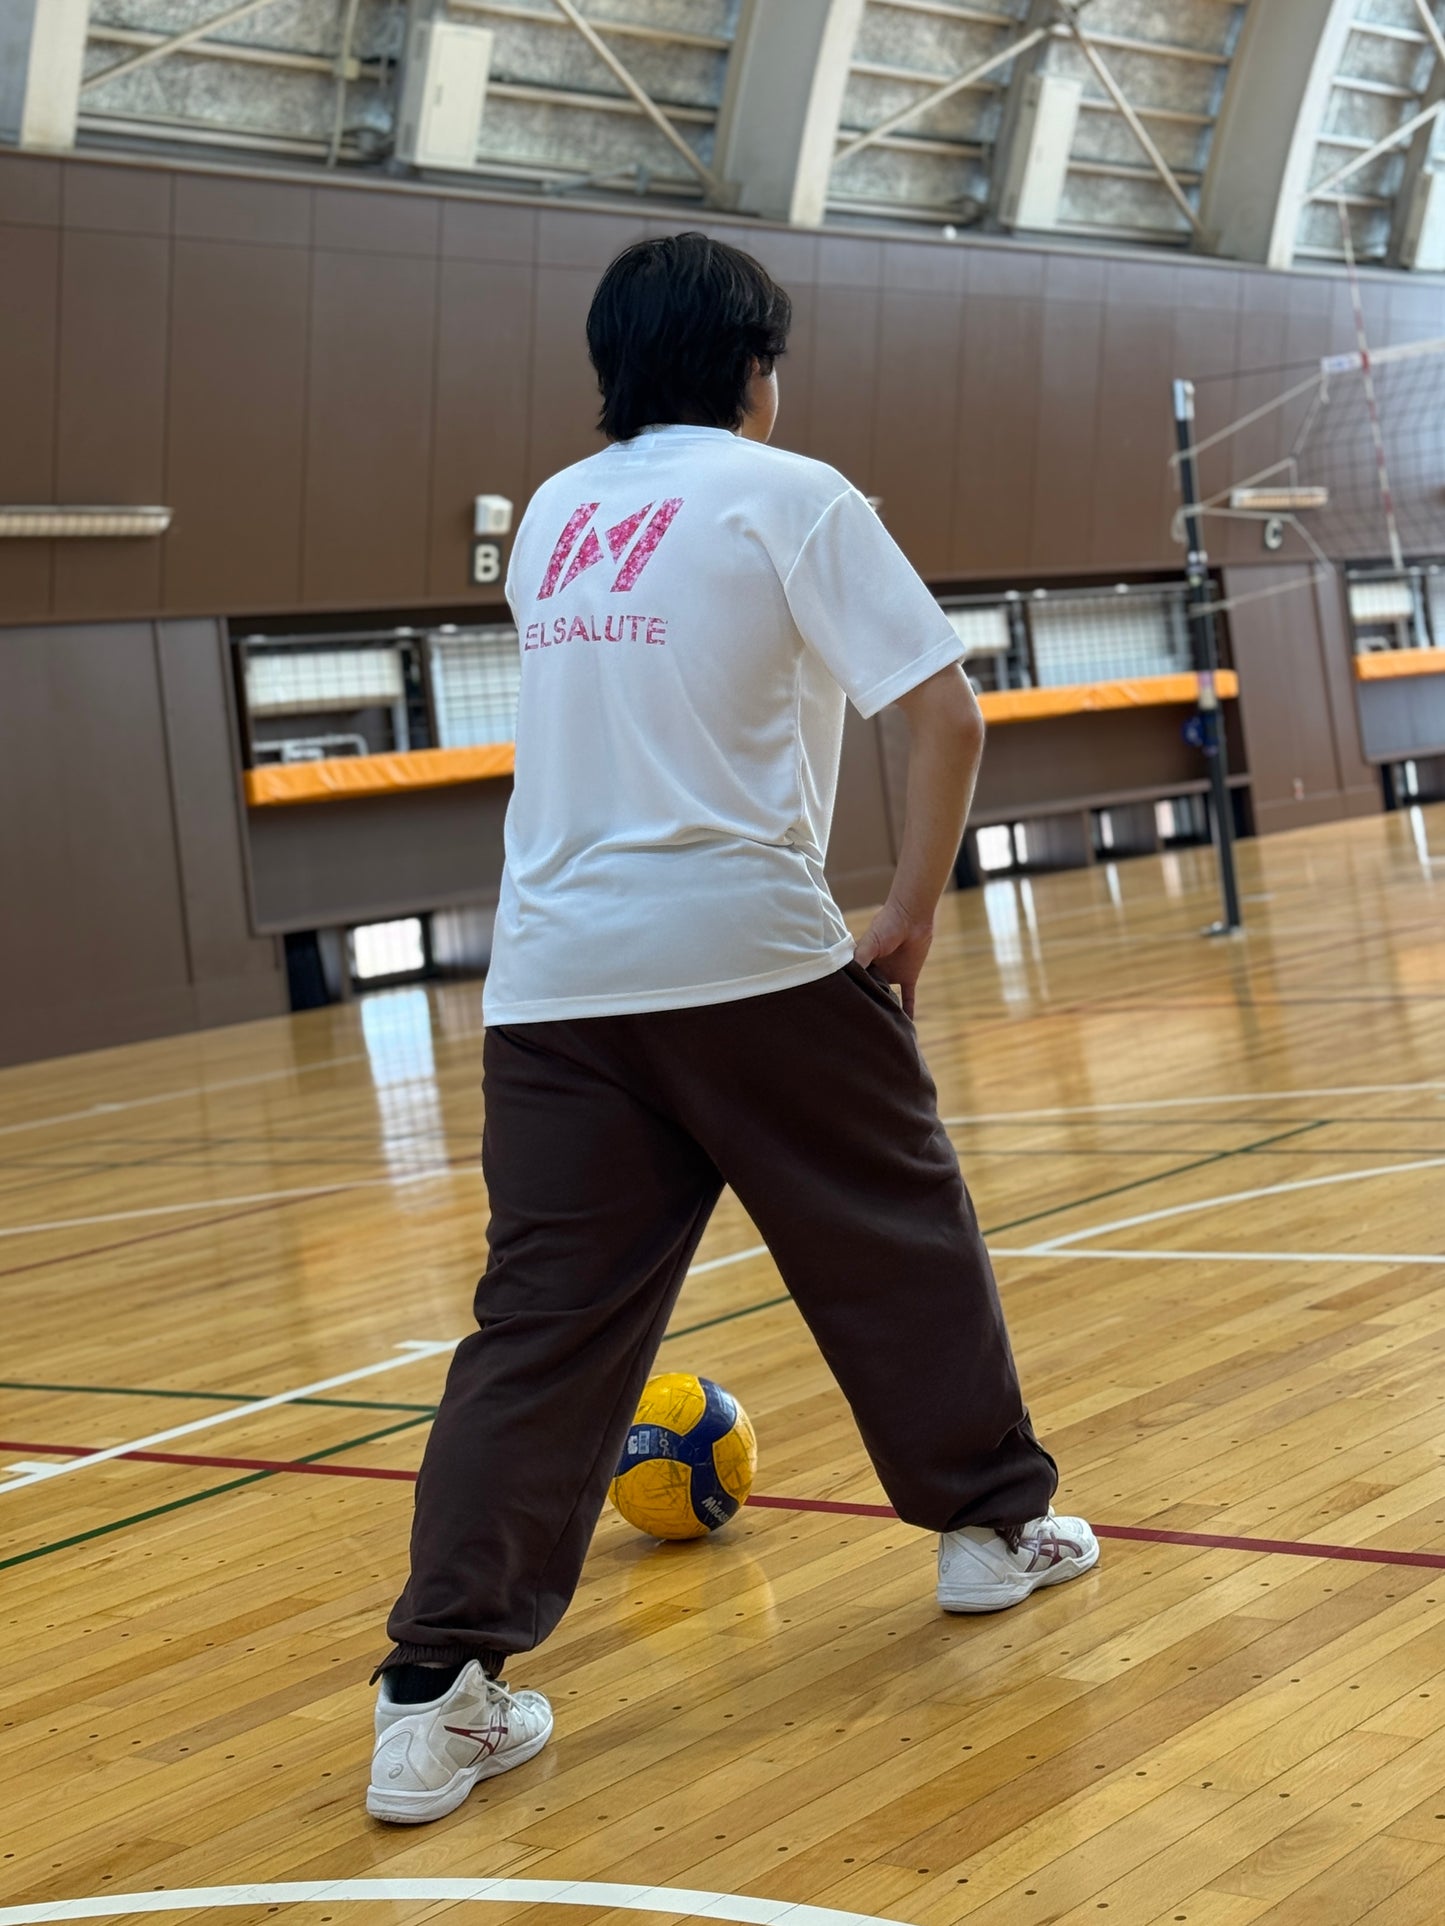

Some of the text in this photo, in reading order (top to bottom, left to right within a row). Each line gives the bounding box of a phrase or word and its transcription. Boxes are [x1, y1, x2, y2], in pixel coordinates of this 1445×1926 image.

[1265, 518, 1284, 550] C
[474, 543, 500, 583] B
[524, 615, 669, 651] ELSALUTE
